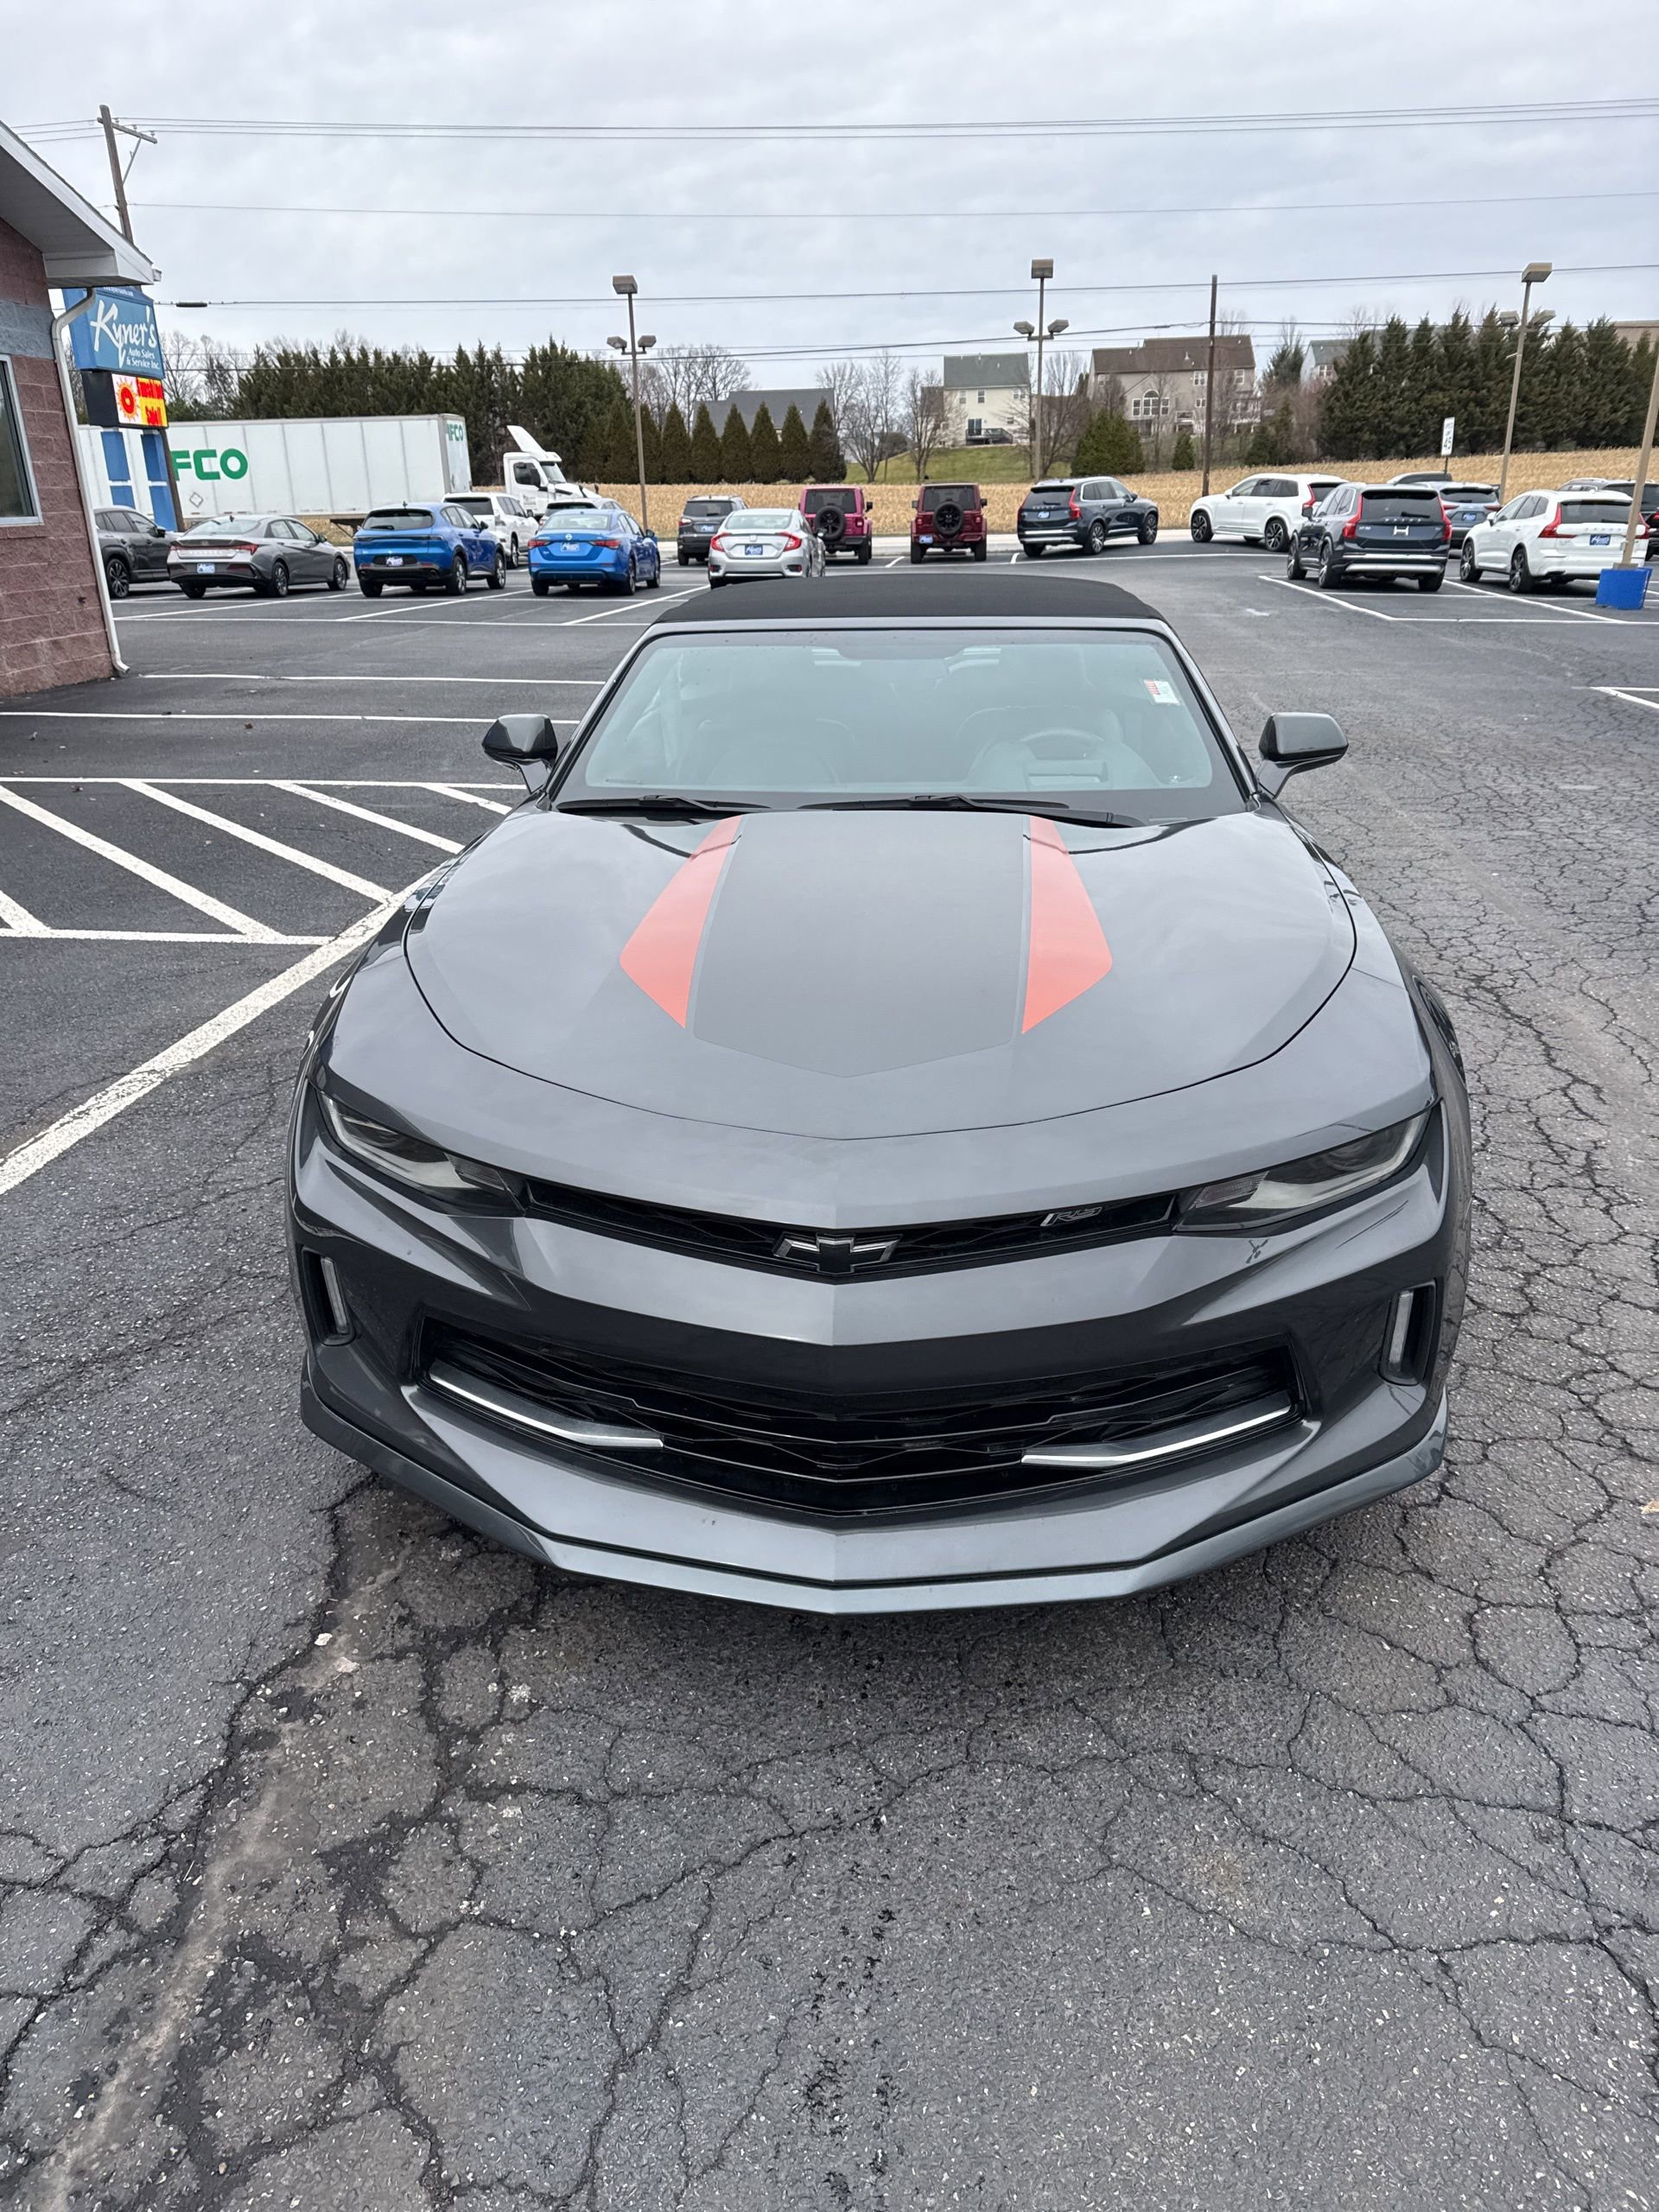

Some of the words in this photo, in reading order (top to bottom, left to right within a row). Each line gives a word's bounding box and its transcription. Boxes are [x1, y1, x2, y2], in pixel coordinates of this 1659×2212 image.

[90, 299, 157, 368] Kyner's
[125, 356, 131, 365] &
[131, 357, 150, 368] Service
[128, 347, 141, 357] Auto
[141, 348, 156, 359] Sales
[169, 448, 249, 481] FCO
[1039, 1206, 1103, 1227] RS
